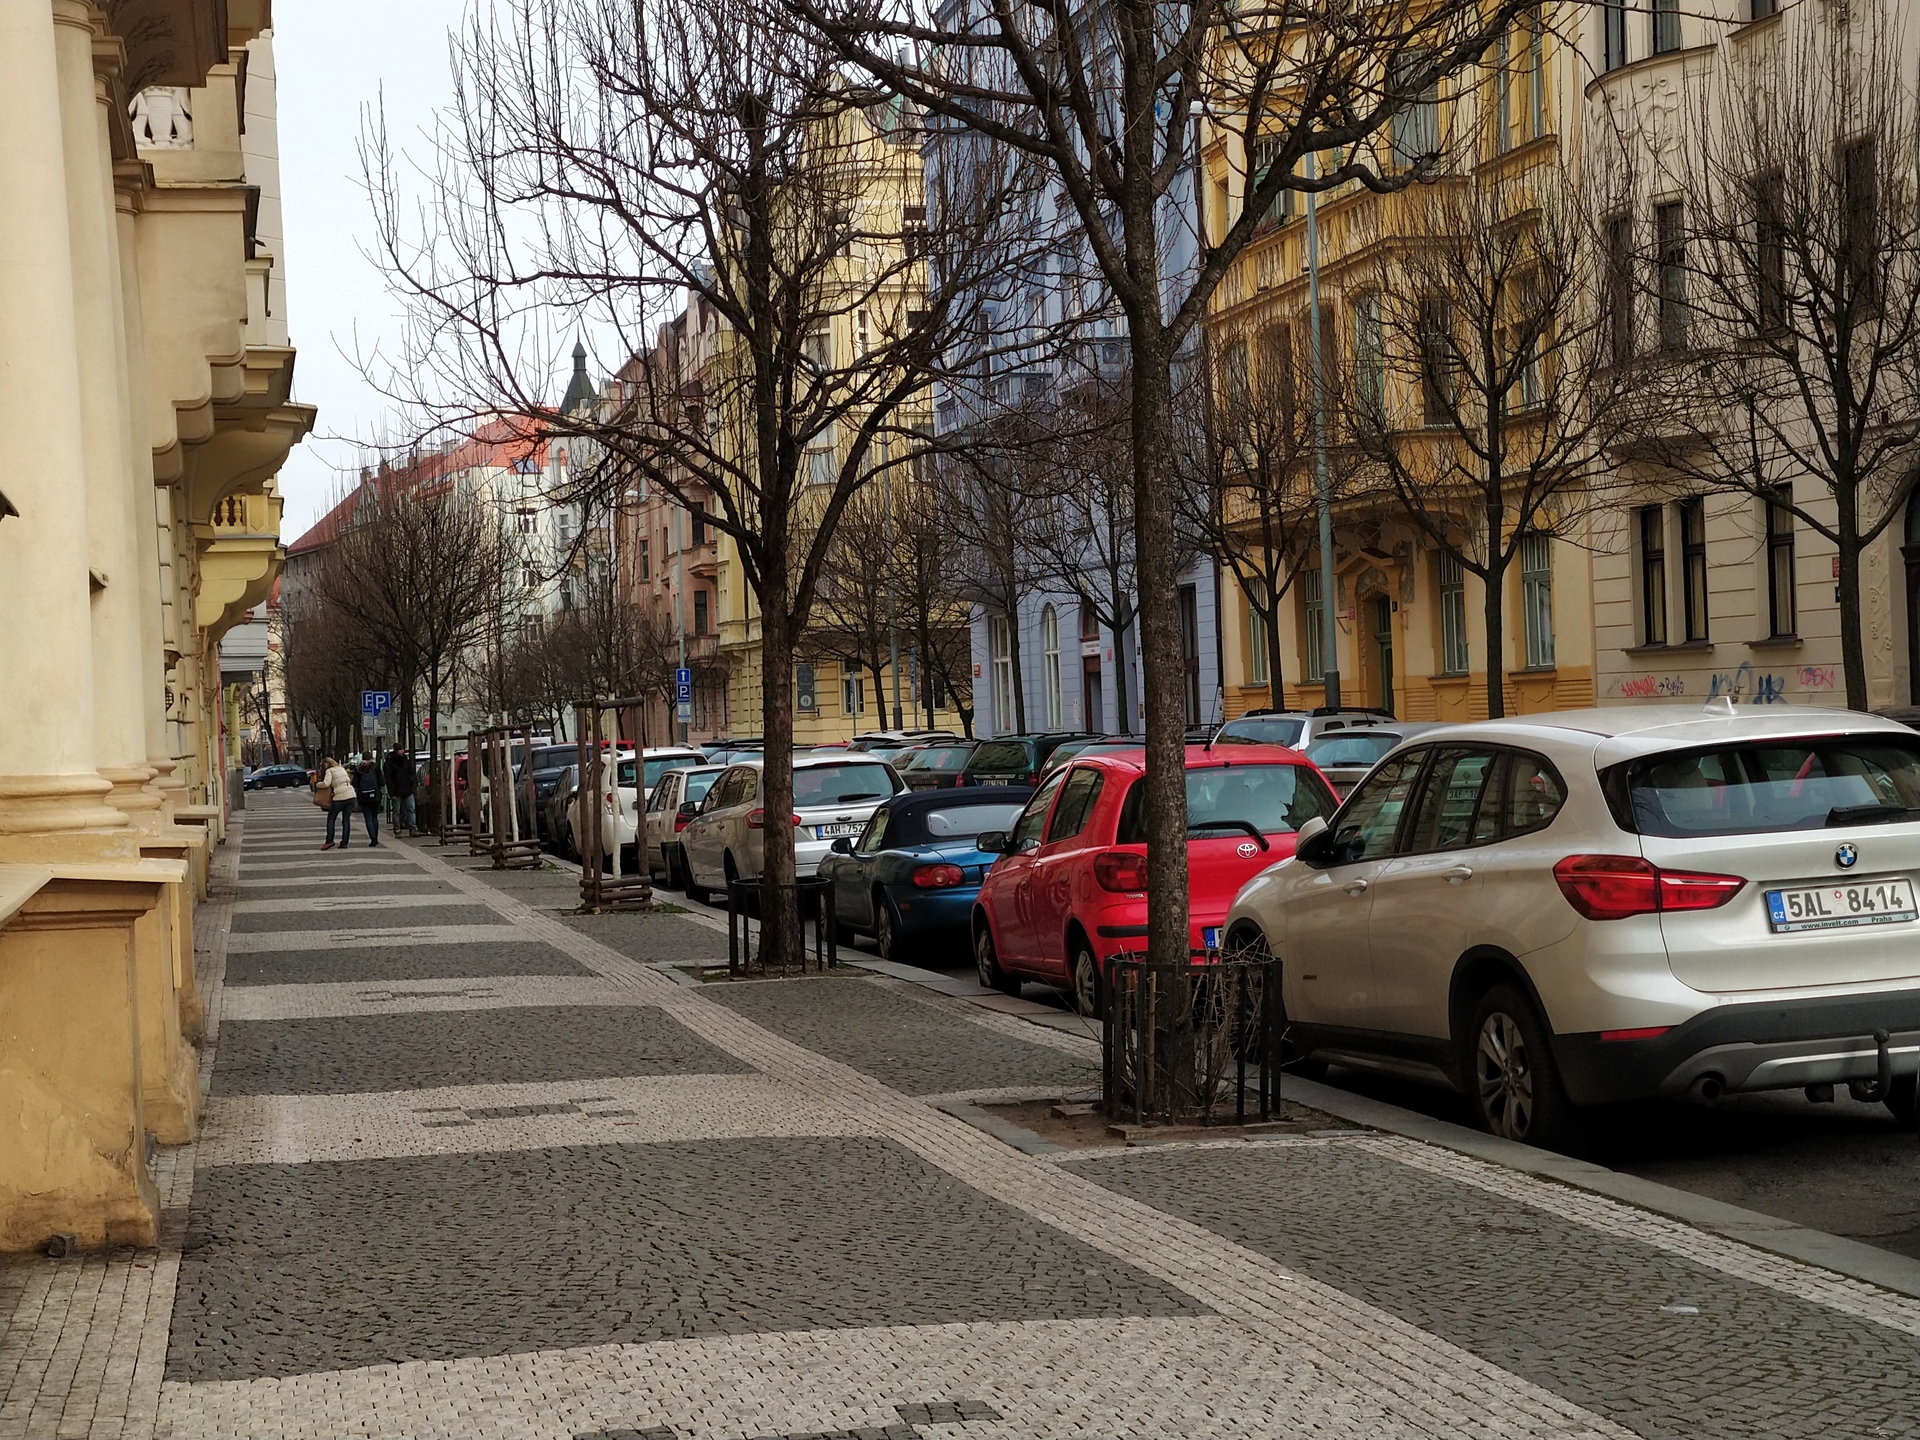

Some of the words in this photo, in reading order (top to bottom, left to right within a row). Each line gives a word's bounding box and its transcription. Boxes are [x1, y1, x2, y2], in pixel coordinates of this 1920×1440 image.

[680, 686, 688, 697] P
[376, 695, 386, 709] P
[824, 825, 841, 835] 4AH
[1787, 892, 1832, 918] 5AL
[1846, 885, 1903, 912] 8414
[1773, 911, 1785, 919] CZ
[1801, 918, 1859, 930] www.invelt.com
[1871, 915, 1893, 923] Praha
